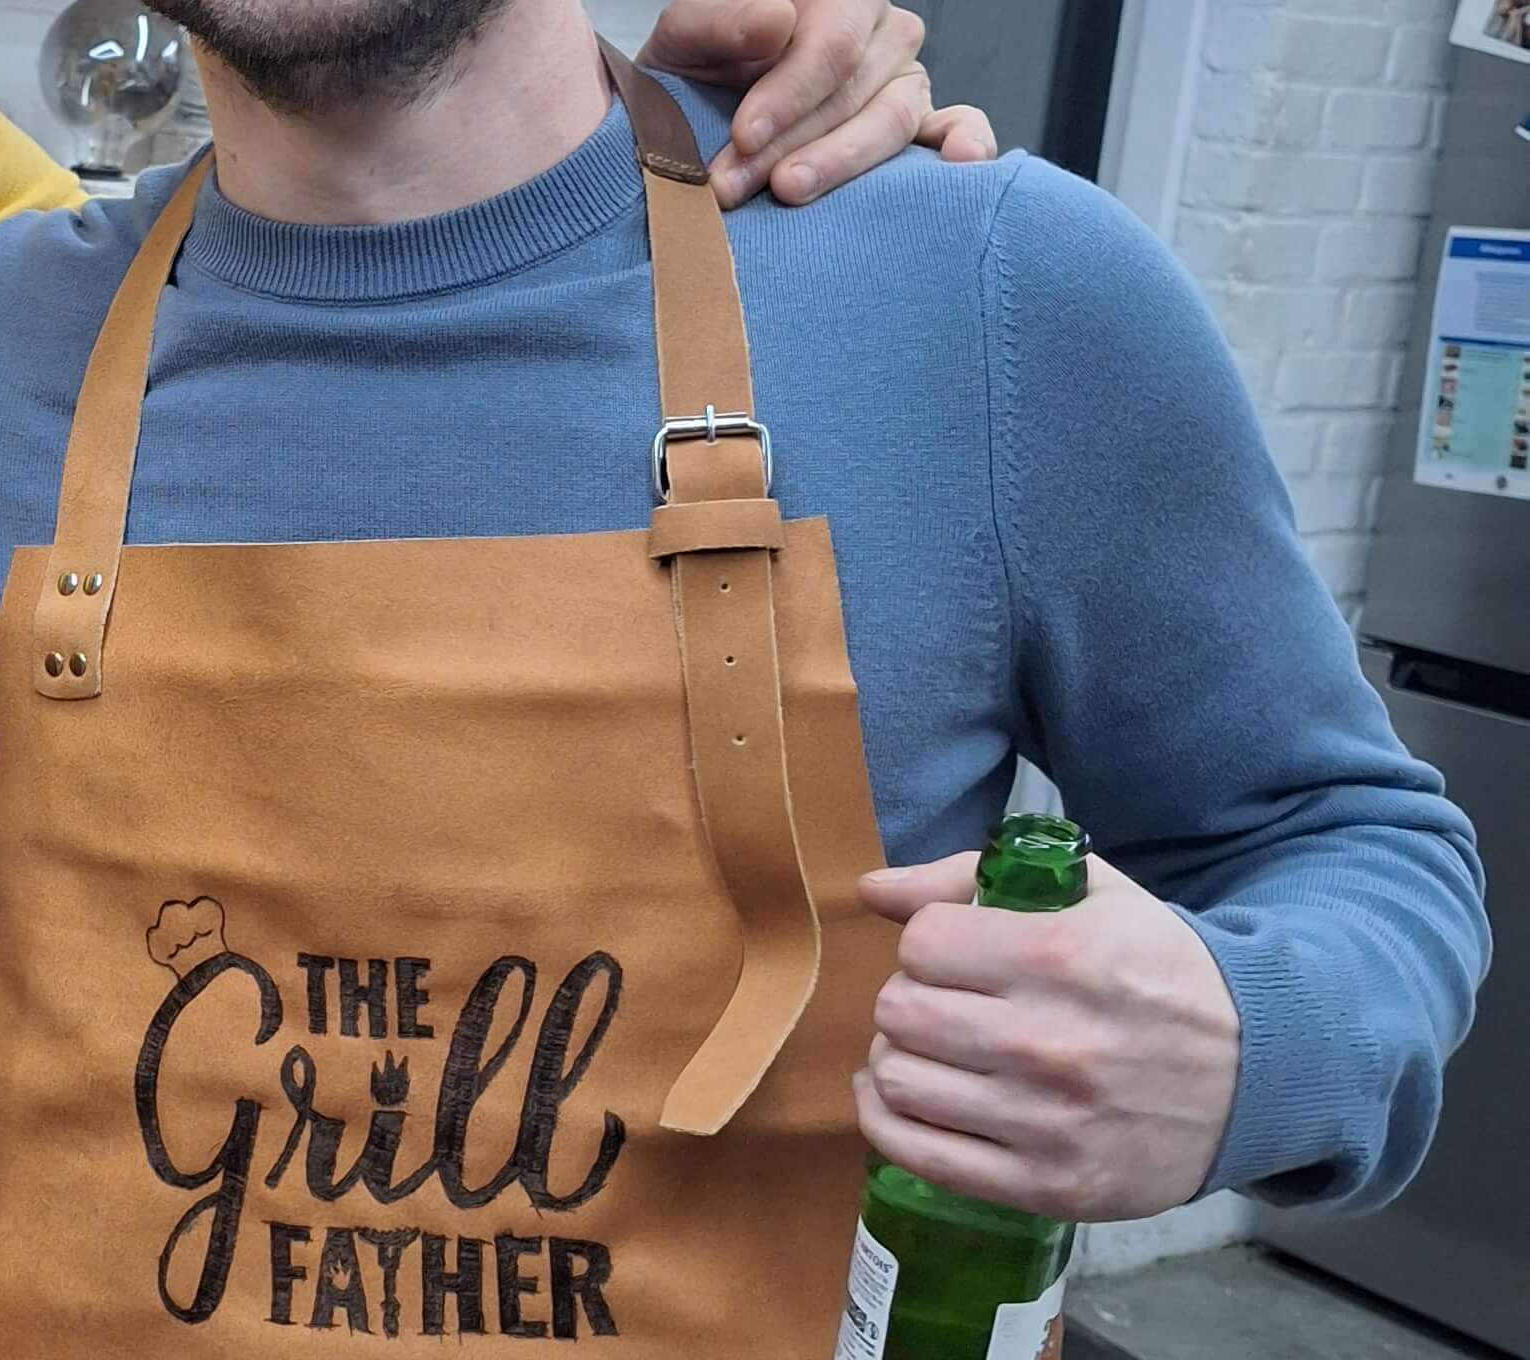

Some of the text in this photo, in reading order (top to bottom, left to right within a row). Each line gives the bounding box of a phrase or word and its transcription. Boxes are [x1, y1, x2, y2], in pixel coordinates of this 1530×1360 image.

[297, 952, 435, 1039] THE
[134, 951, 627, 1326] Grill
[264, 1222, 619, 1339] FATHER
